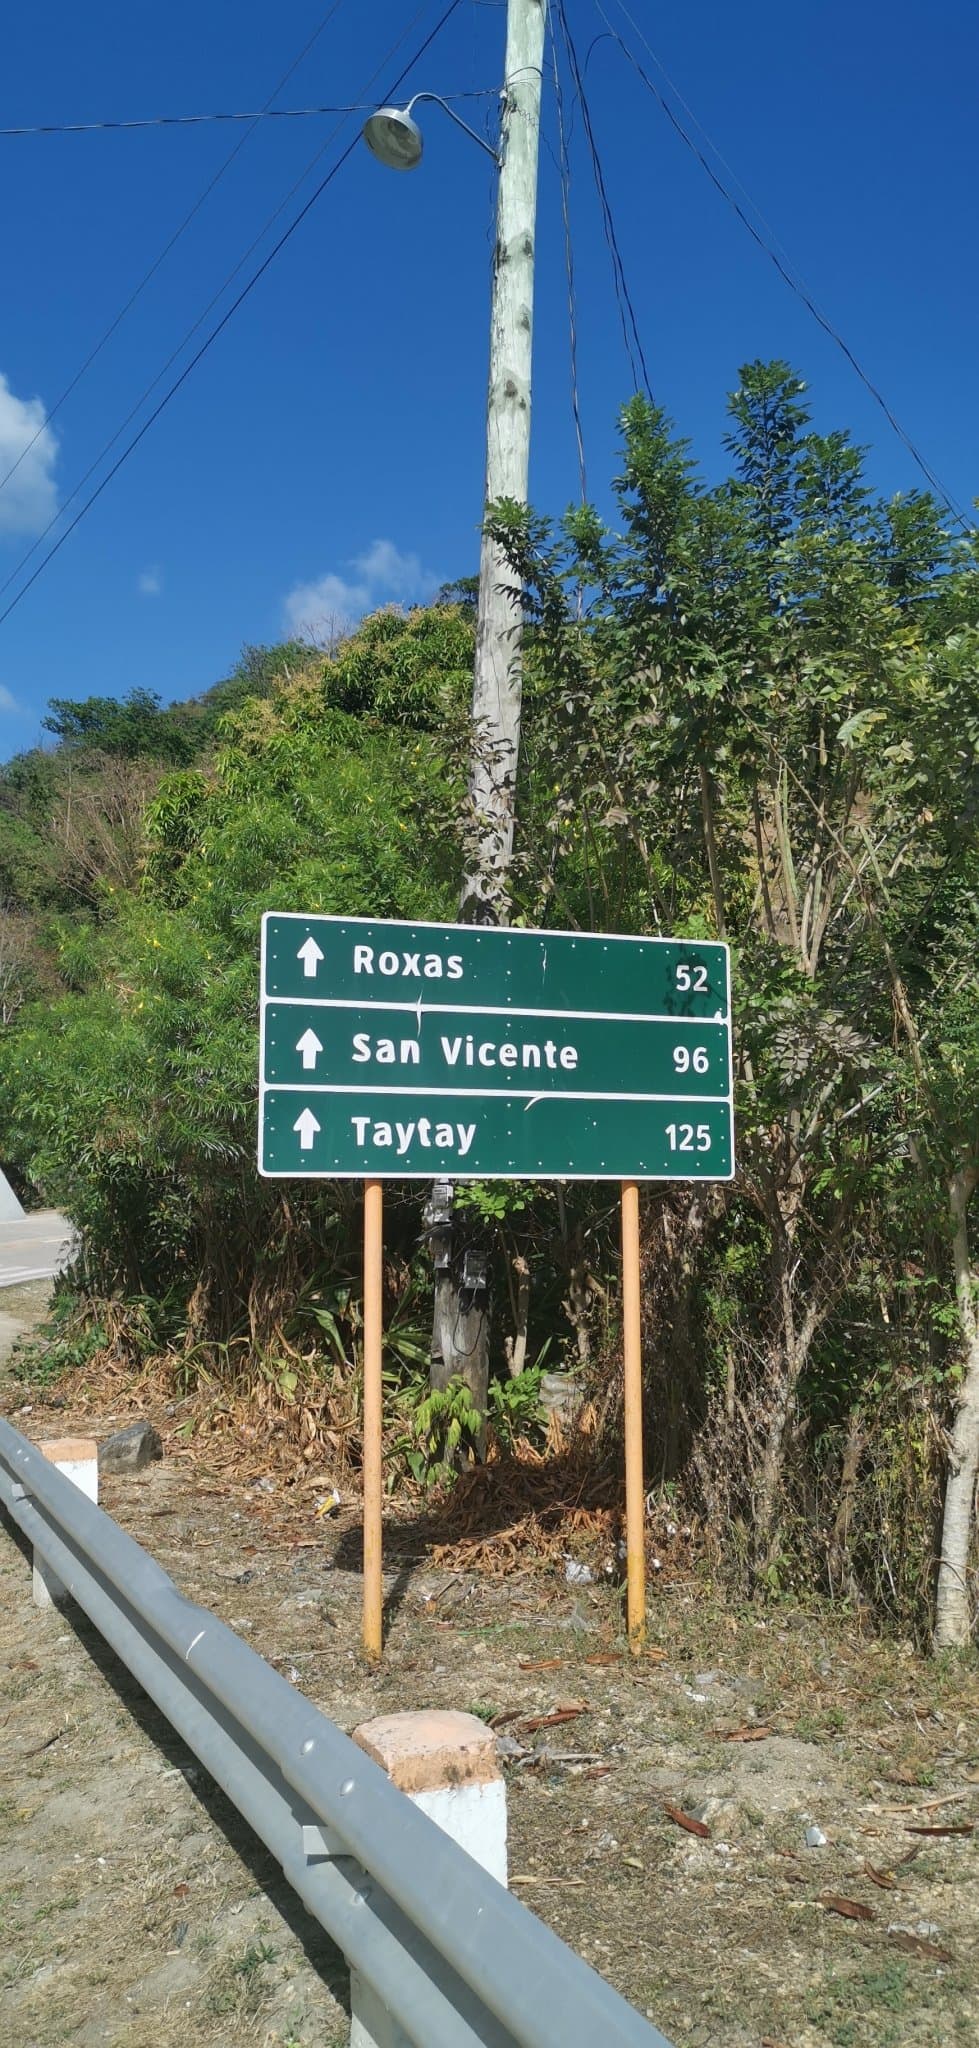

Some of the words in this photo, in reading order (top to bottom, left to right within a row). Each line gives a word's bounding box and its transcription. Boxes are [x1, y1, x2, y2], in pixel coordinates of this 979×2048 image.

[353, 944, 464, 979] Roxas
[676, 964, 708, 992] 52
[351, 1032, 422, 1064] San
[440, 1036, 578, 1071] Vicente
[672, 1046, 710, 1073] 96
[350, 1116, 477, 1156] Taytay
[664, 1123, 712, 1152] 125
